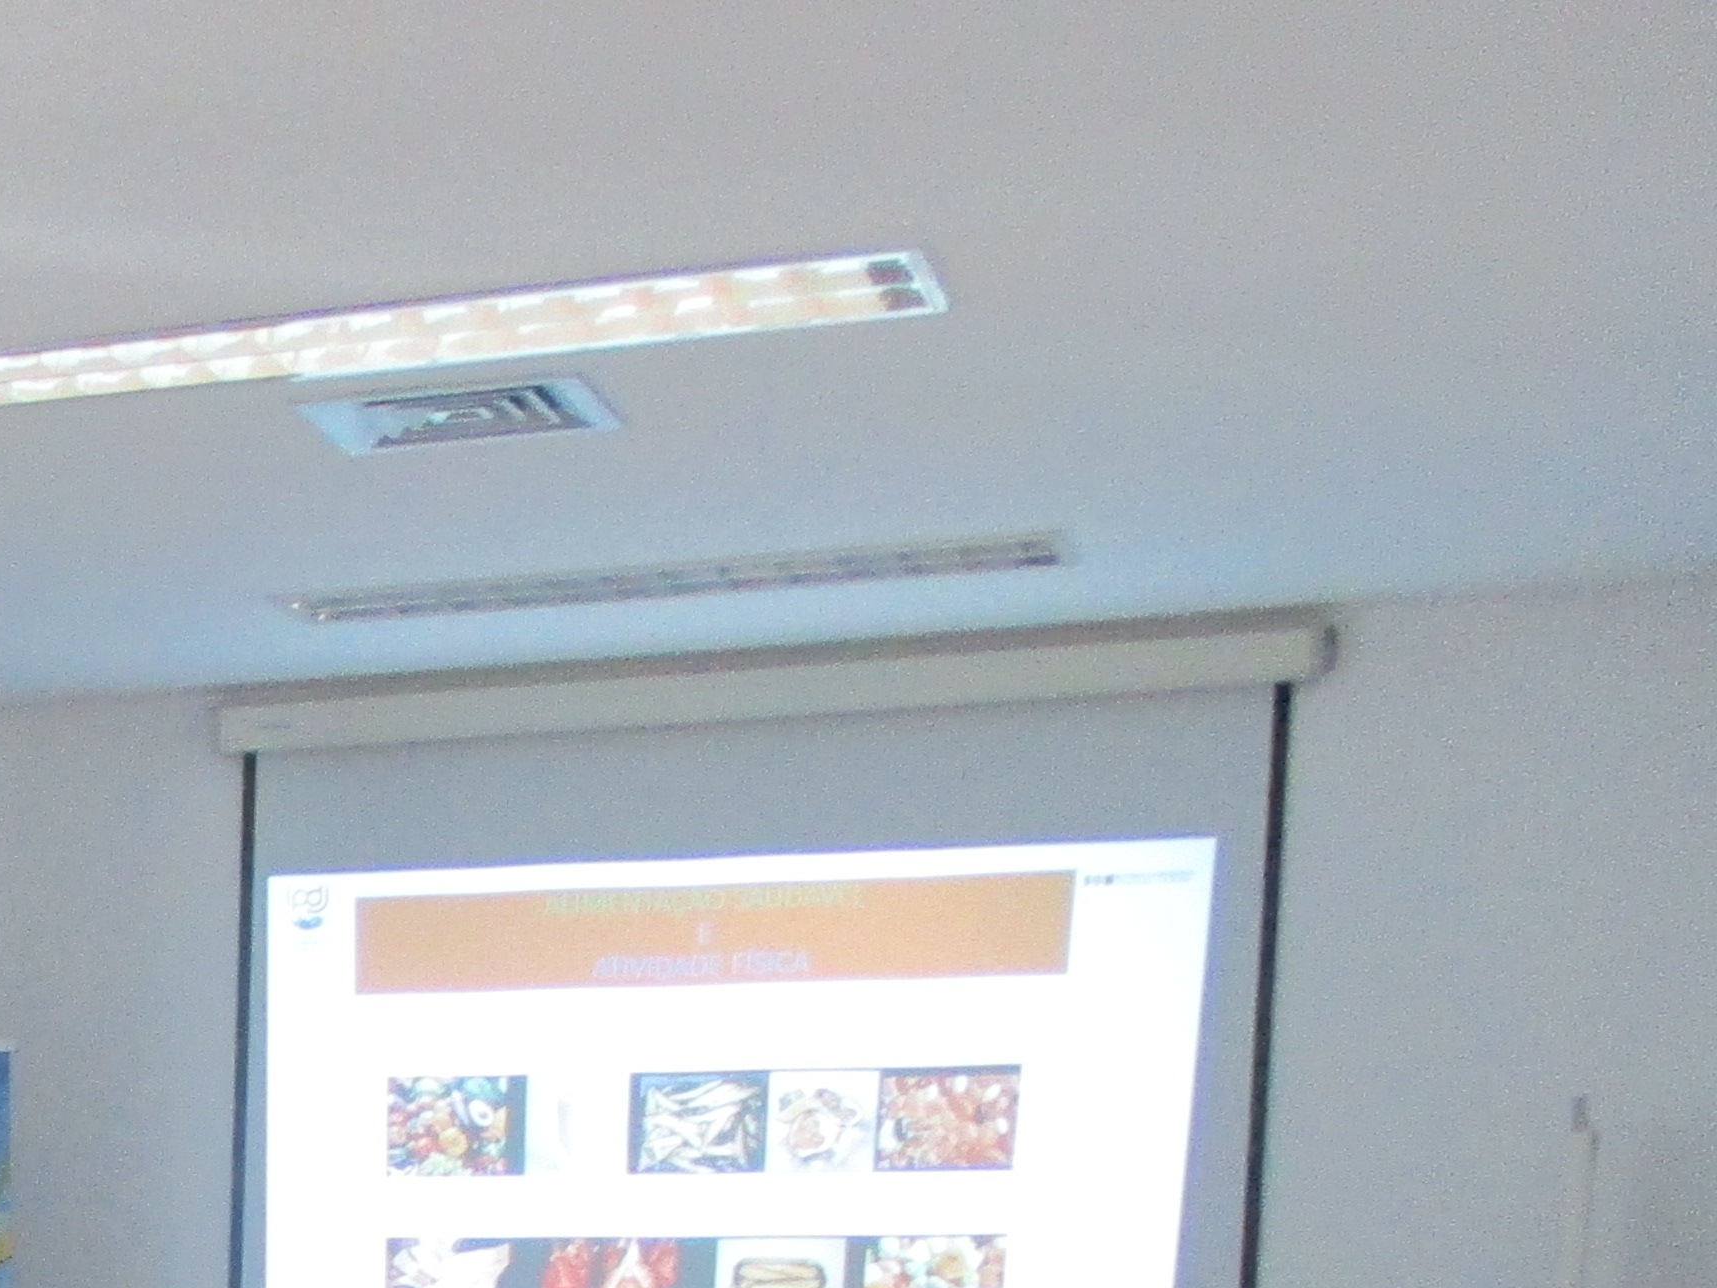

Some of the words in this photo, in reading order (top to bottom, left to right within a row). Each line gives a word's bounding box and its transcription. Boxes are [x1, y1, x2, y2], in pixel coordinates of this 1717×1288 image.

[545, 886, 727, 917] ALIMENTAÇÃO
[593, 954, 723, 980] ATIVIDADE
[731, 947, 813, 974] FÍSICA
